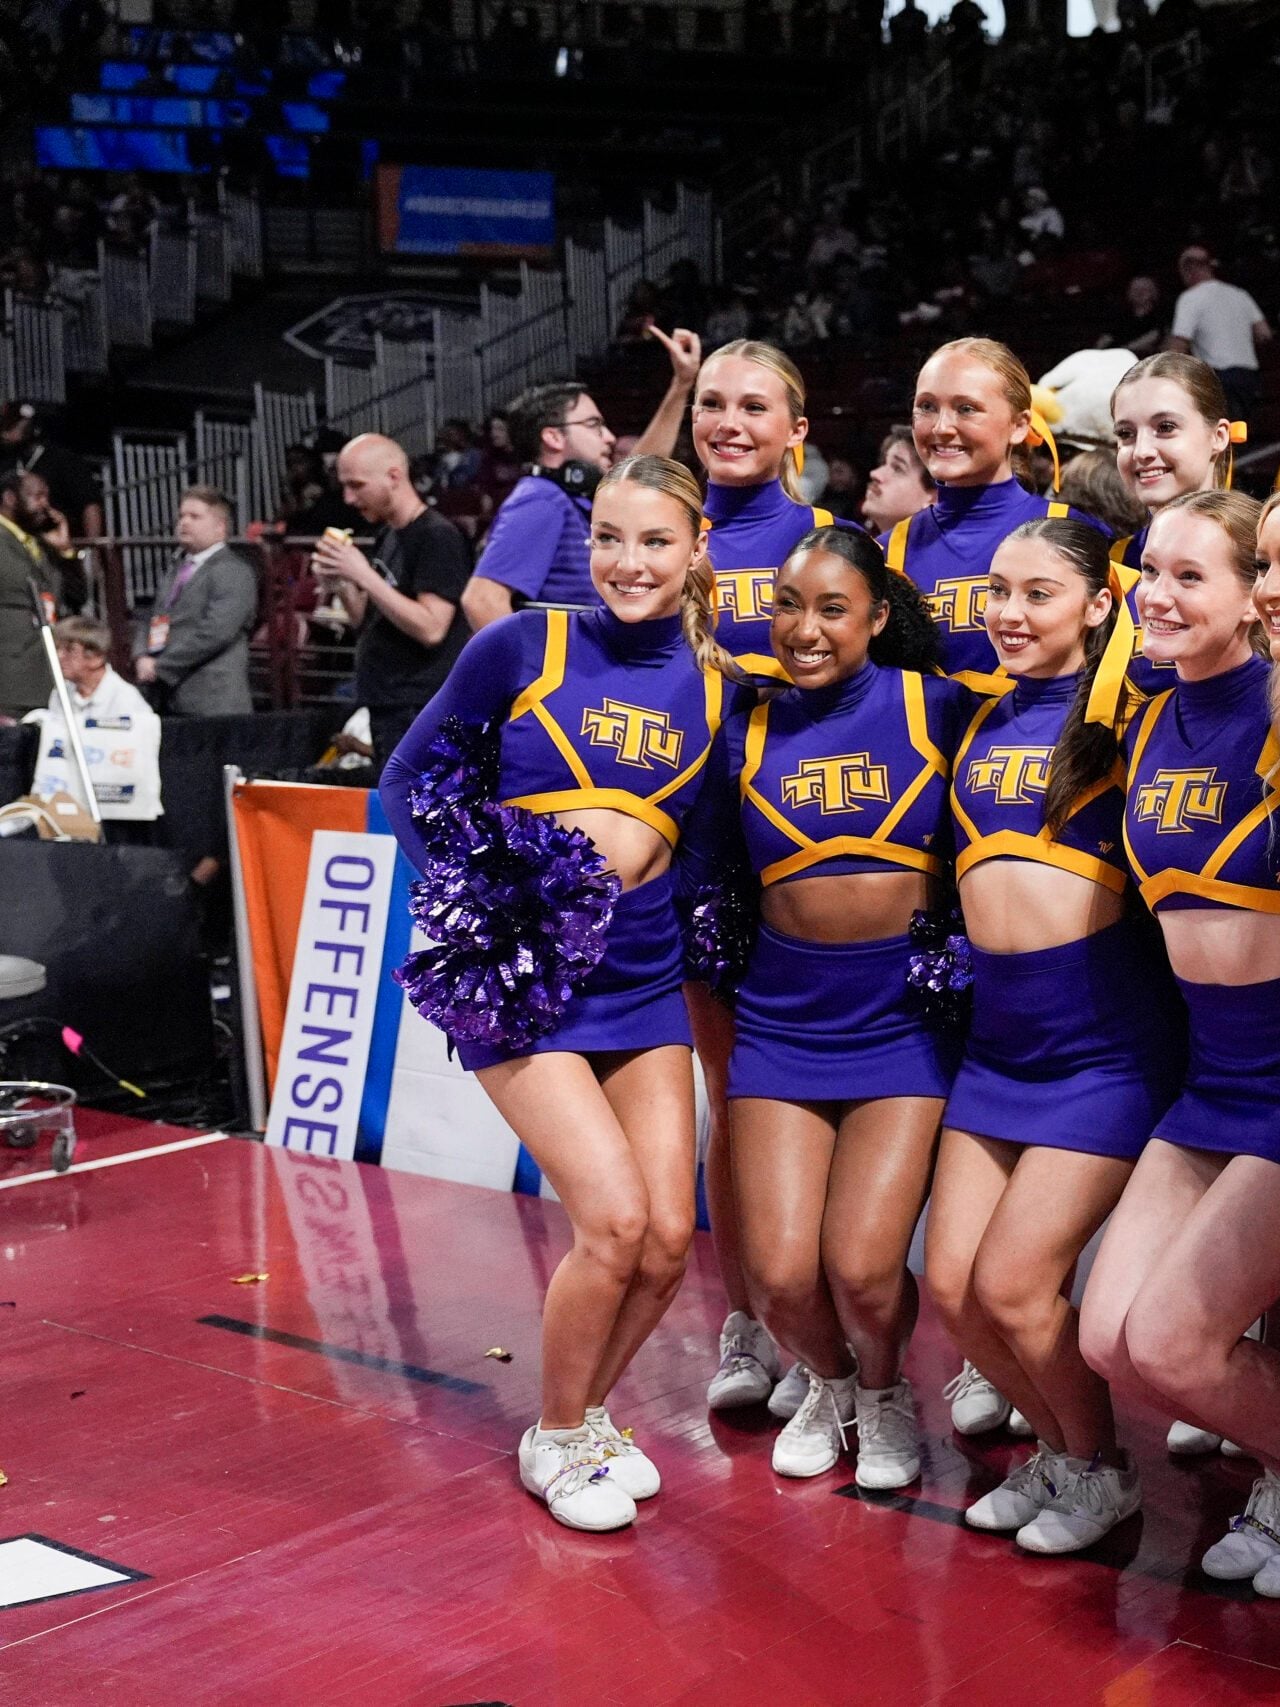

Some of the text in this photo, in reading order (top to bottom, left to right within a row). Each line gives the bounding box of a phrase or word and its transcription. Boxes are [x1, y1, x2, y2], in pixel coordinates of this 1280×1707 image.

[580, 697, 684, 770] TTU
[781, 752, 891, 815] TTU
[1137, 767, 1228, 834] TTU
[282, 855, 375, 1157] OFFENSE
